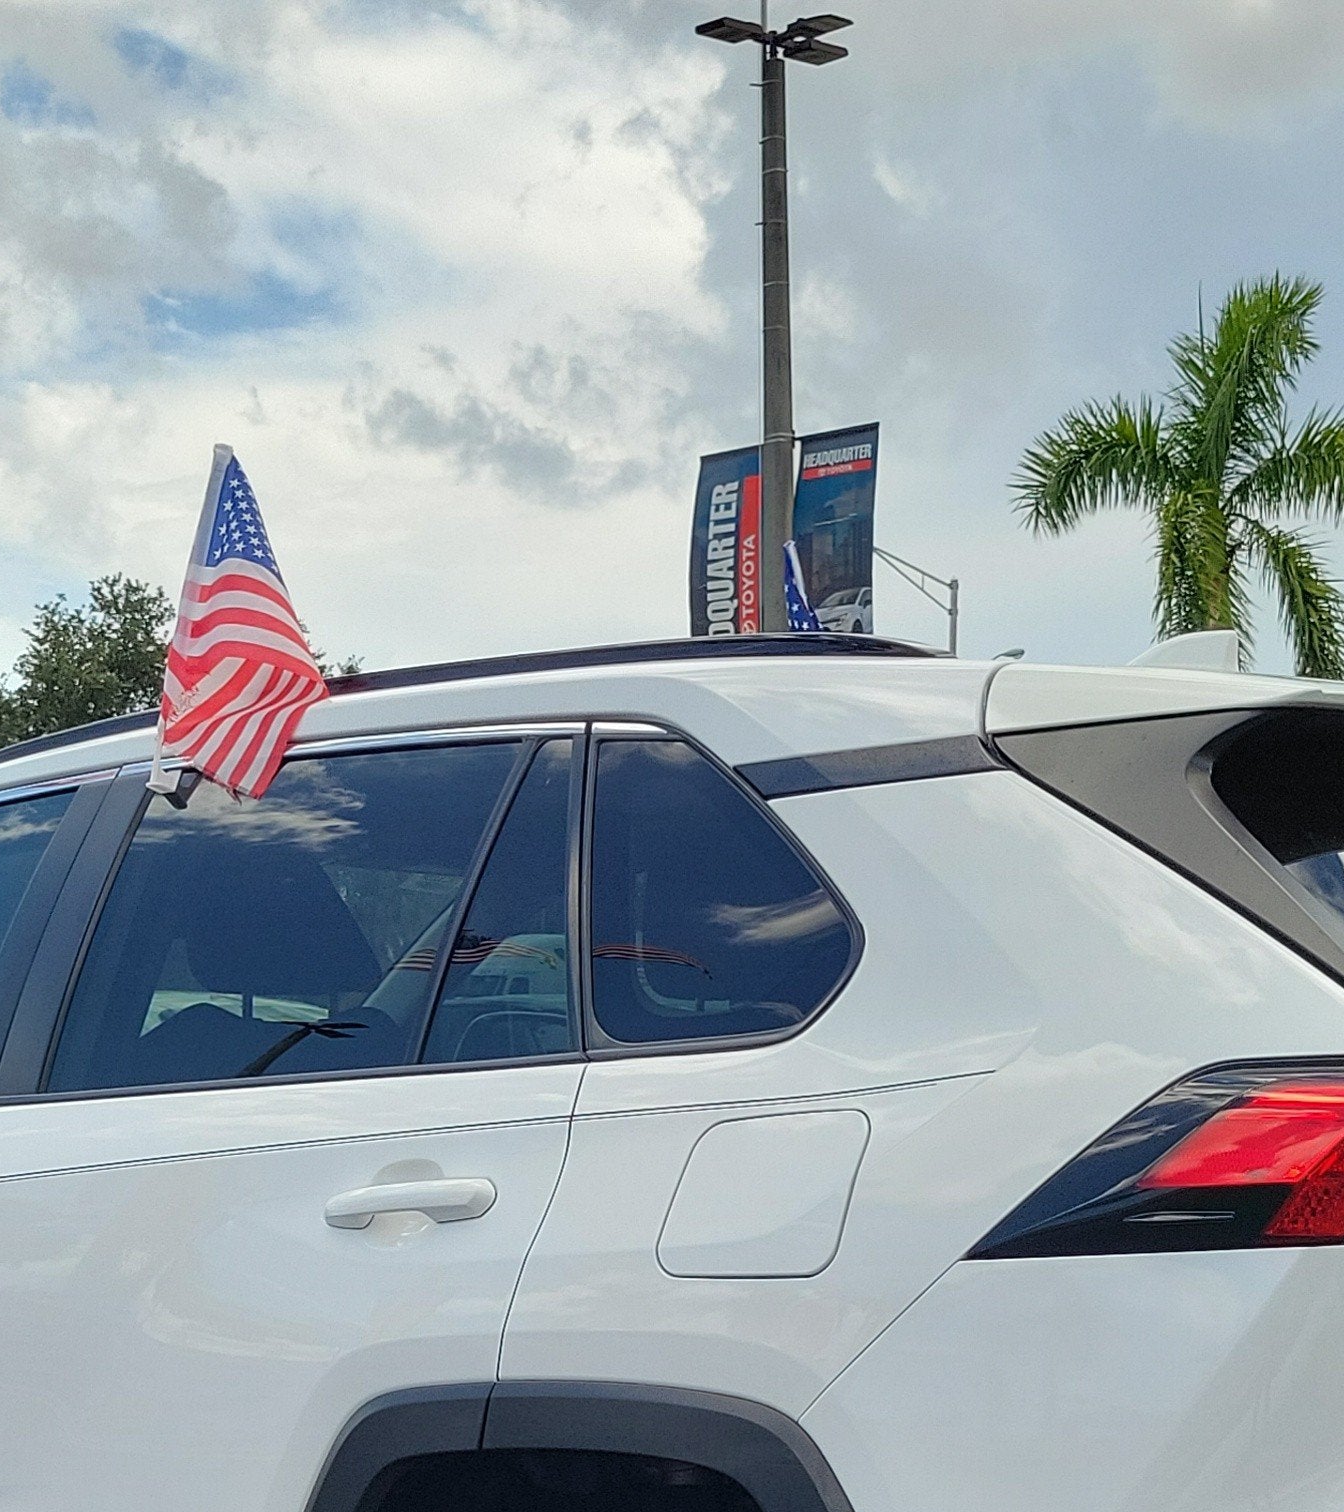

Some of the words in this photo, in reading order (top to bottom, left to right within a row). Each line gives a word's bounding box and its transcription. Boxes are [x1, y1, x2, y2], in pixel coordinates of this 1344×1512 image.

[803, 443, 872, 470] HEADQUARTER
[706, 480, 741, 637] DQUARTER
[742, 534, 756, 617] TOYOTA
